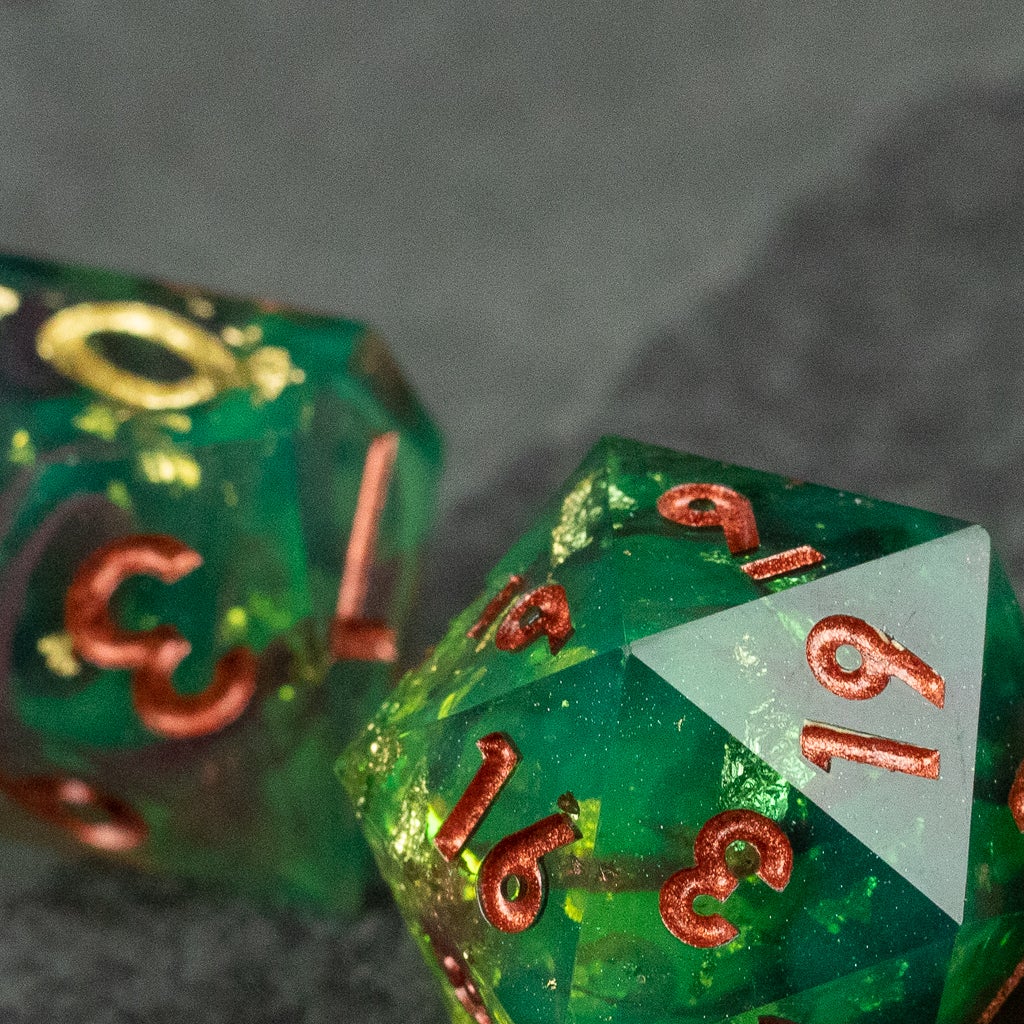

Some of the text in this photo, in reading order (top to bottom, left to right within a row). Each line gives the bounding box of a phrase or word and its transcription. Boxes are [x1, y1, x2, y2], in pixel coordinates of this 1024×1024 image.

[37, 302, 236, 410] 0
[65, 534, 256, 737] 3
[801, 613, 946, 781] 19
[434, 731, 580, 934] 16
[660, 809, 793, 949] 3
